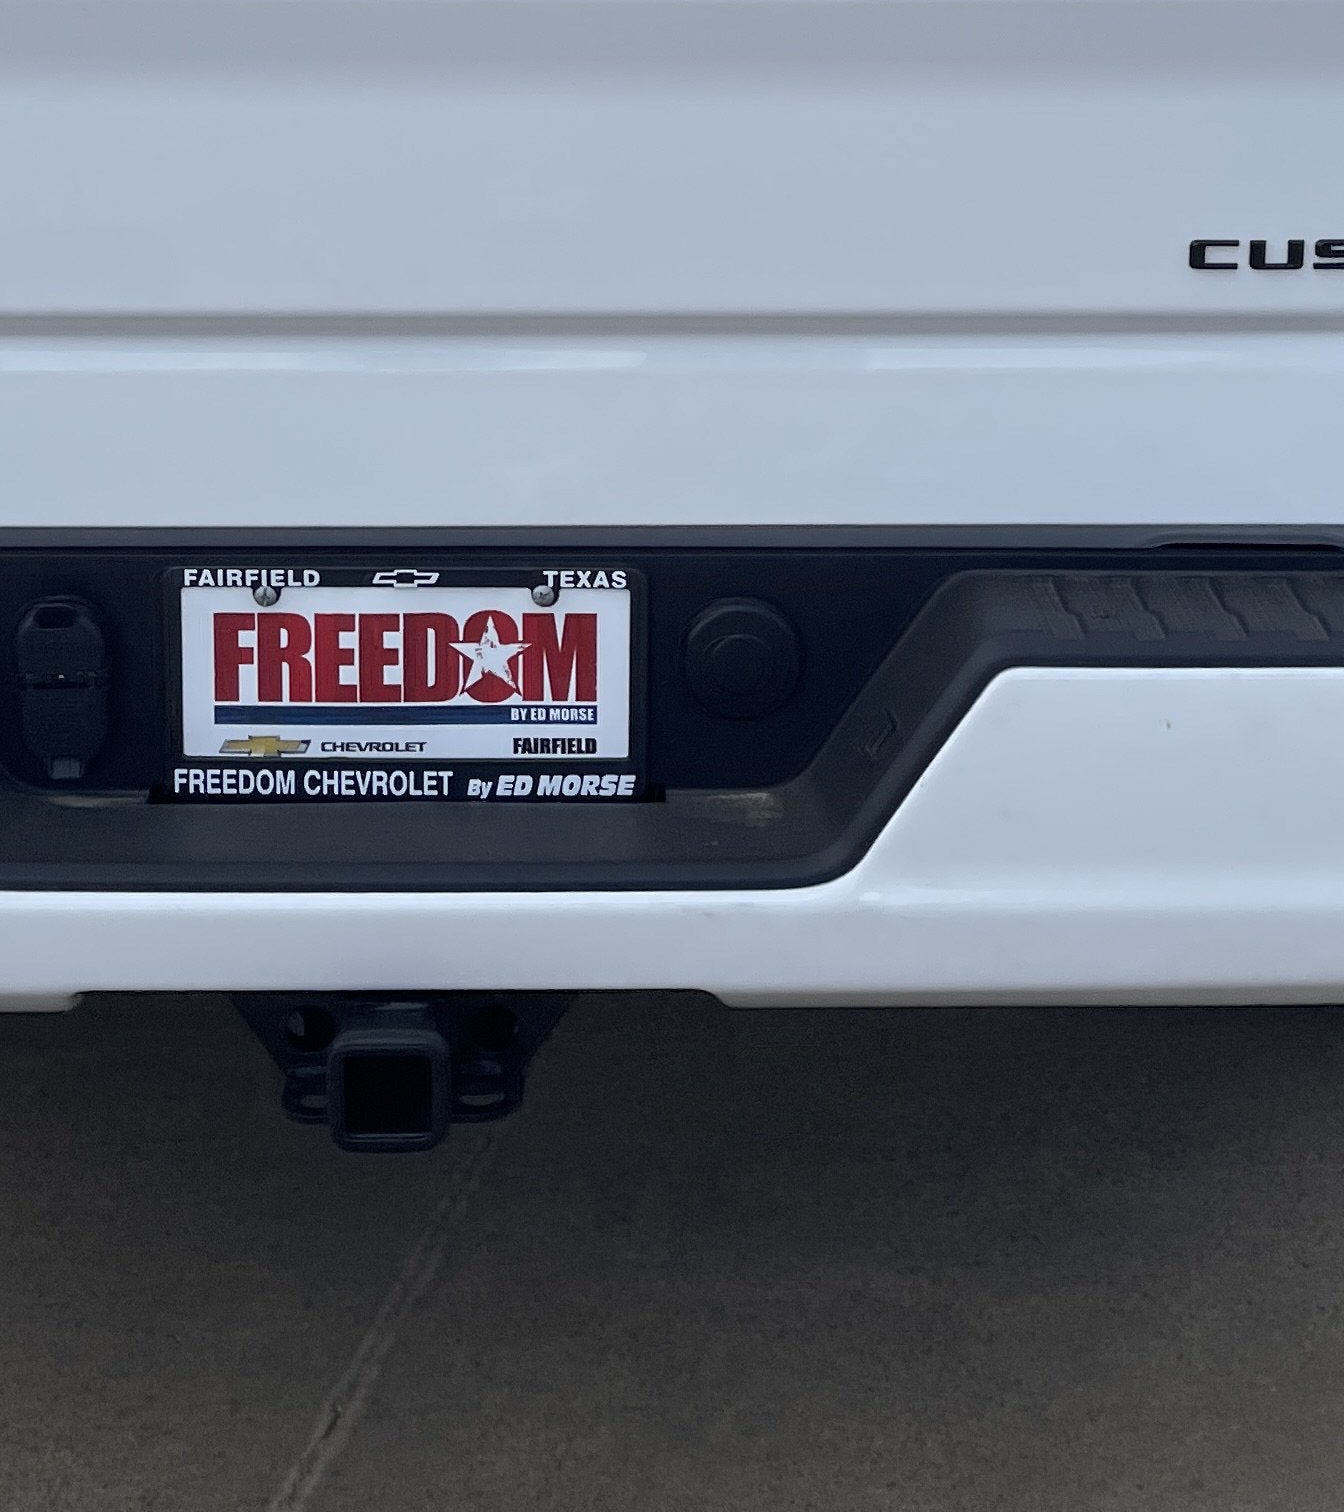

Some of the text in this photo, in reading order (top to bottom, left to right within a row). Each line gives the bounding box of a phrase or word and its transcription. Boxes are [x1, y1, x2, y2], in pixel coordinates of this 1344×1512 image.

[183, 568, 628, 589] FAIRFIELD TEXAS
[212, 609, 598, 703] FREEDOM
[510, 707, 595, 722] BY ED MORSE
[320, 740, 428, 754] CHEVROLET
[512, 737, 598, 755] FAIRFIELD
[174, 768, 636, 800] FREEDOM CHEVROLET By ED MORSE
